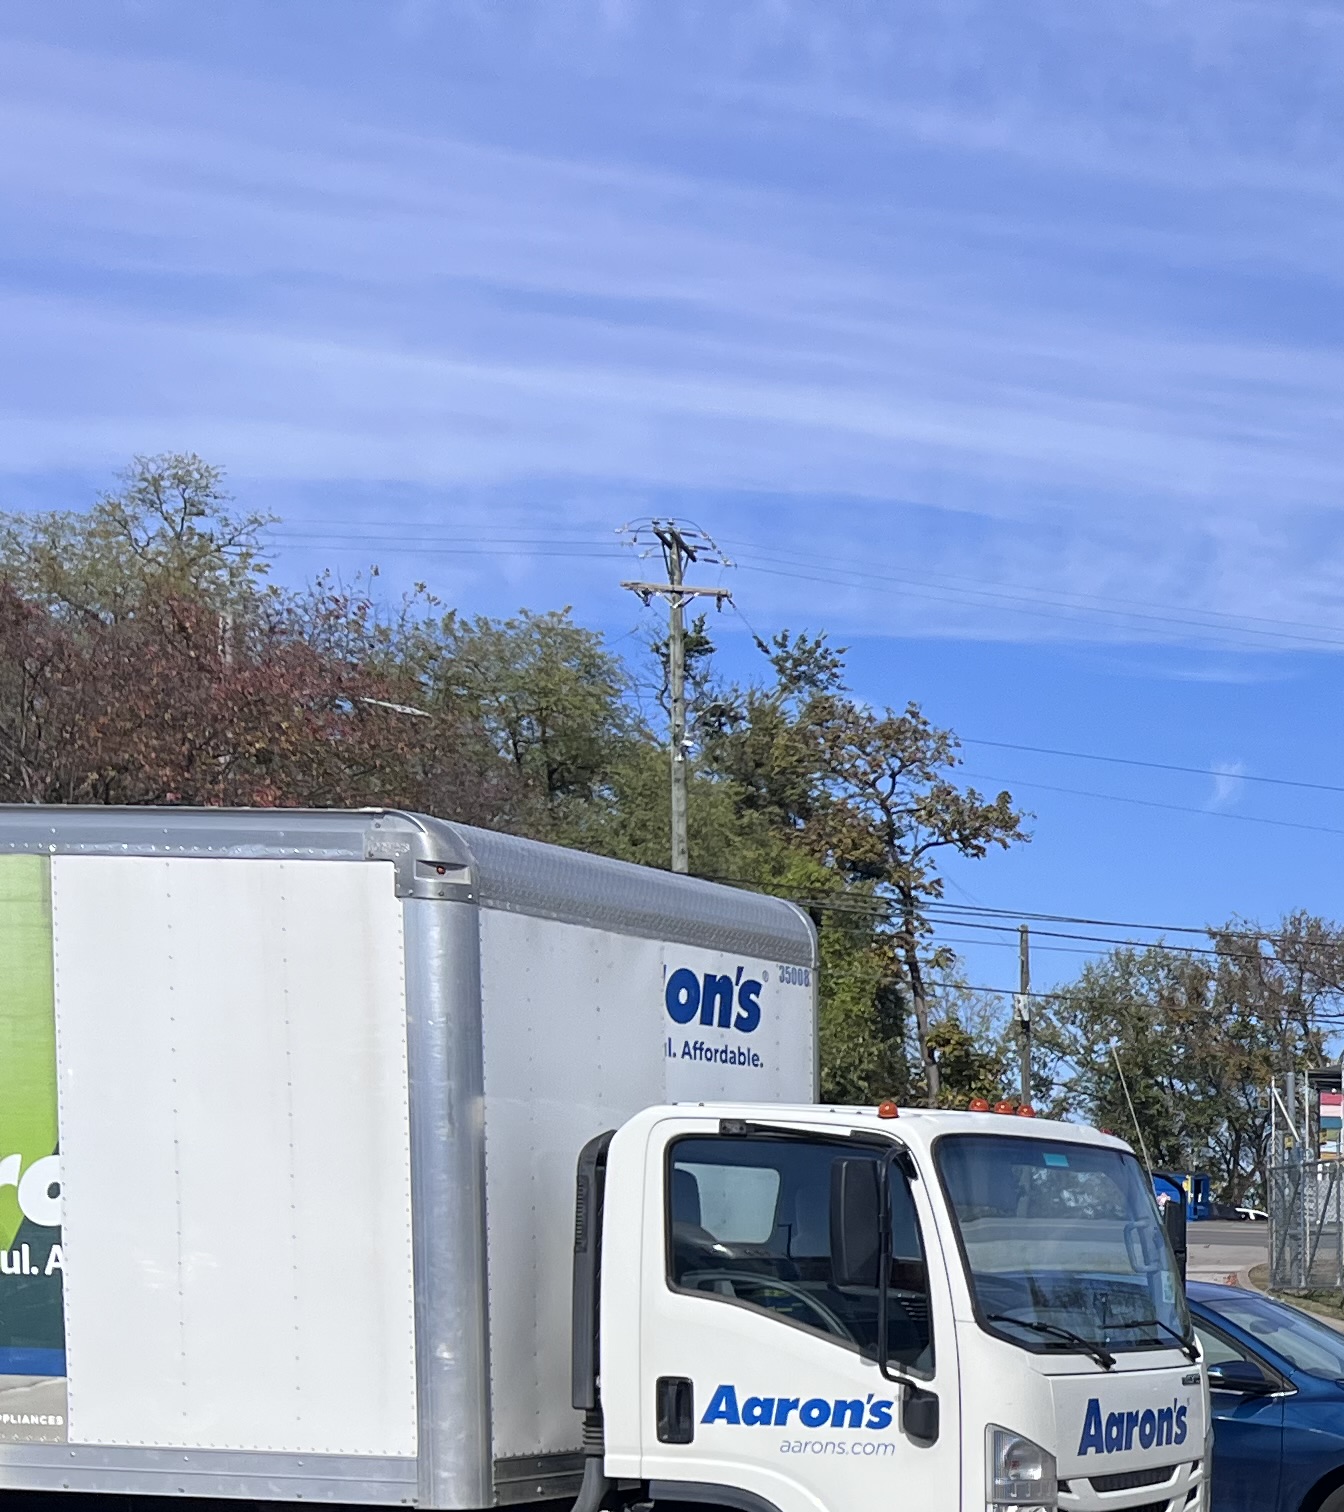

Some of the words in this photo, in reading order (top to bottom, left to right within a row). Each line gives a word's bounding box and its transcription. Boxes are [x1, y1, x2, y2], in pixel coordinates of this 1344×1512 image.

[663, 965, 763, 1033] on's
[681, 1040, 764, 1069] Affordable.
[0, 1413, 64, 1426] PLIANCES
[700, 1385, 894, 1430] Aaron's
[1077, 1398, 1188, 1456] Aaron's
[779, 1440, 896, 1456] aarons.com
